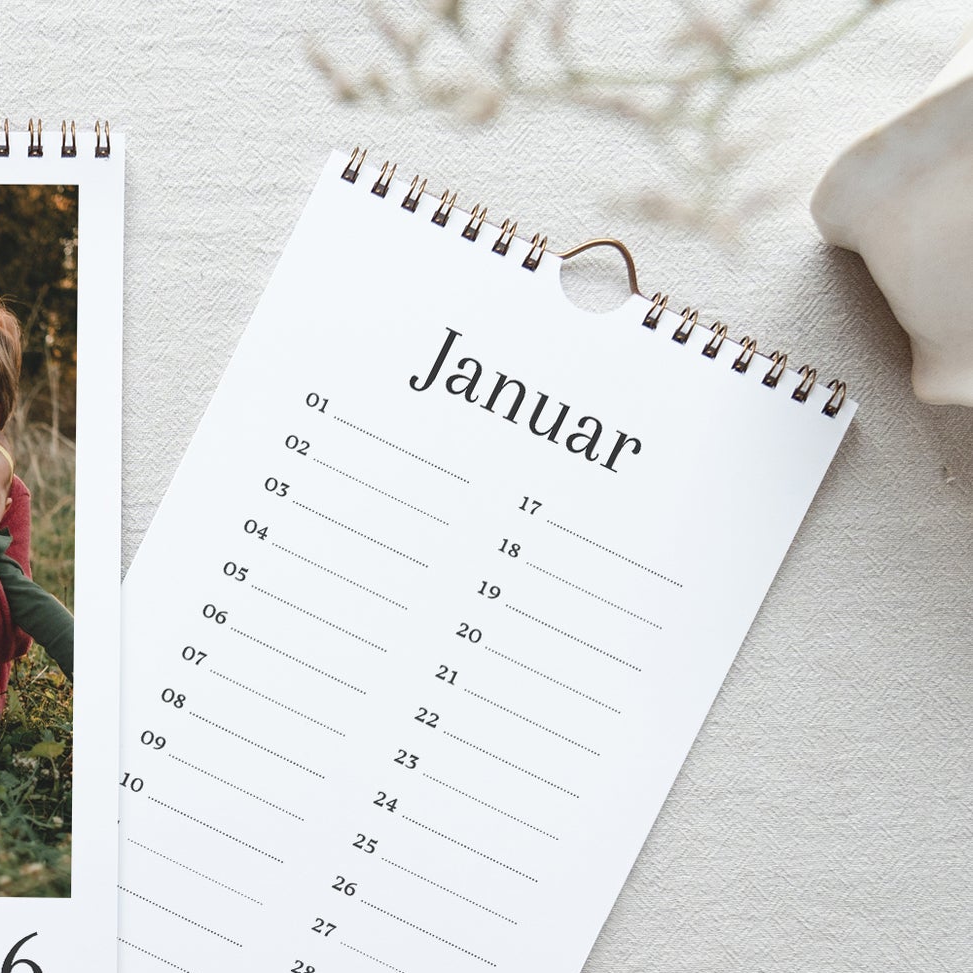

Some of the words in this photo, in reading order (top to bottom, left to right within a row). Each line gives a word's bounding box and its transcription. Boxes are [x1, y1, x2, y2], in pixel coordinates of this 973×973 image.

[305, 392, 329, 414] 01
[409, 326, 642, 473] Januar
[284, 434, 311, 456] 02
[264, 477, 291, 498] 03
[518, 496, 543, 515] 17
[243, 519, 269, 541] 04
[498, 538, 521, 558] 18
[223, 561, 249, 582] 05
[477, 580, 501, 600] 19
[202, 603, 228, 625] 06
[455, 622, 483, 644] 20
[181, 645, 208, 666] 07
[434, 664, 458, 686] 21
[161, 688, 187, 709] 08
[414, 707, 440, 729] 22
[140, 730, 167, 750] 09
[393, 748, 420, 770] 23
[119, 772, 144, 793] 10
[372, 791, 398, 813] 24
[352, 833, 379, 854] 25
[331, 875, 358, 897] 26
[311, 917, 337, 937] 27
